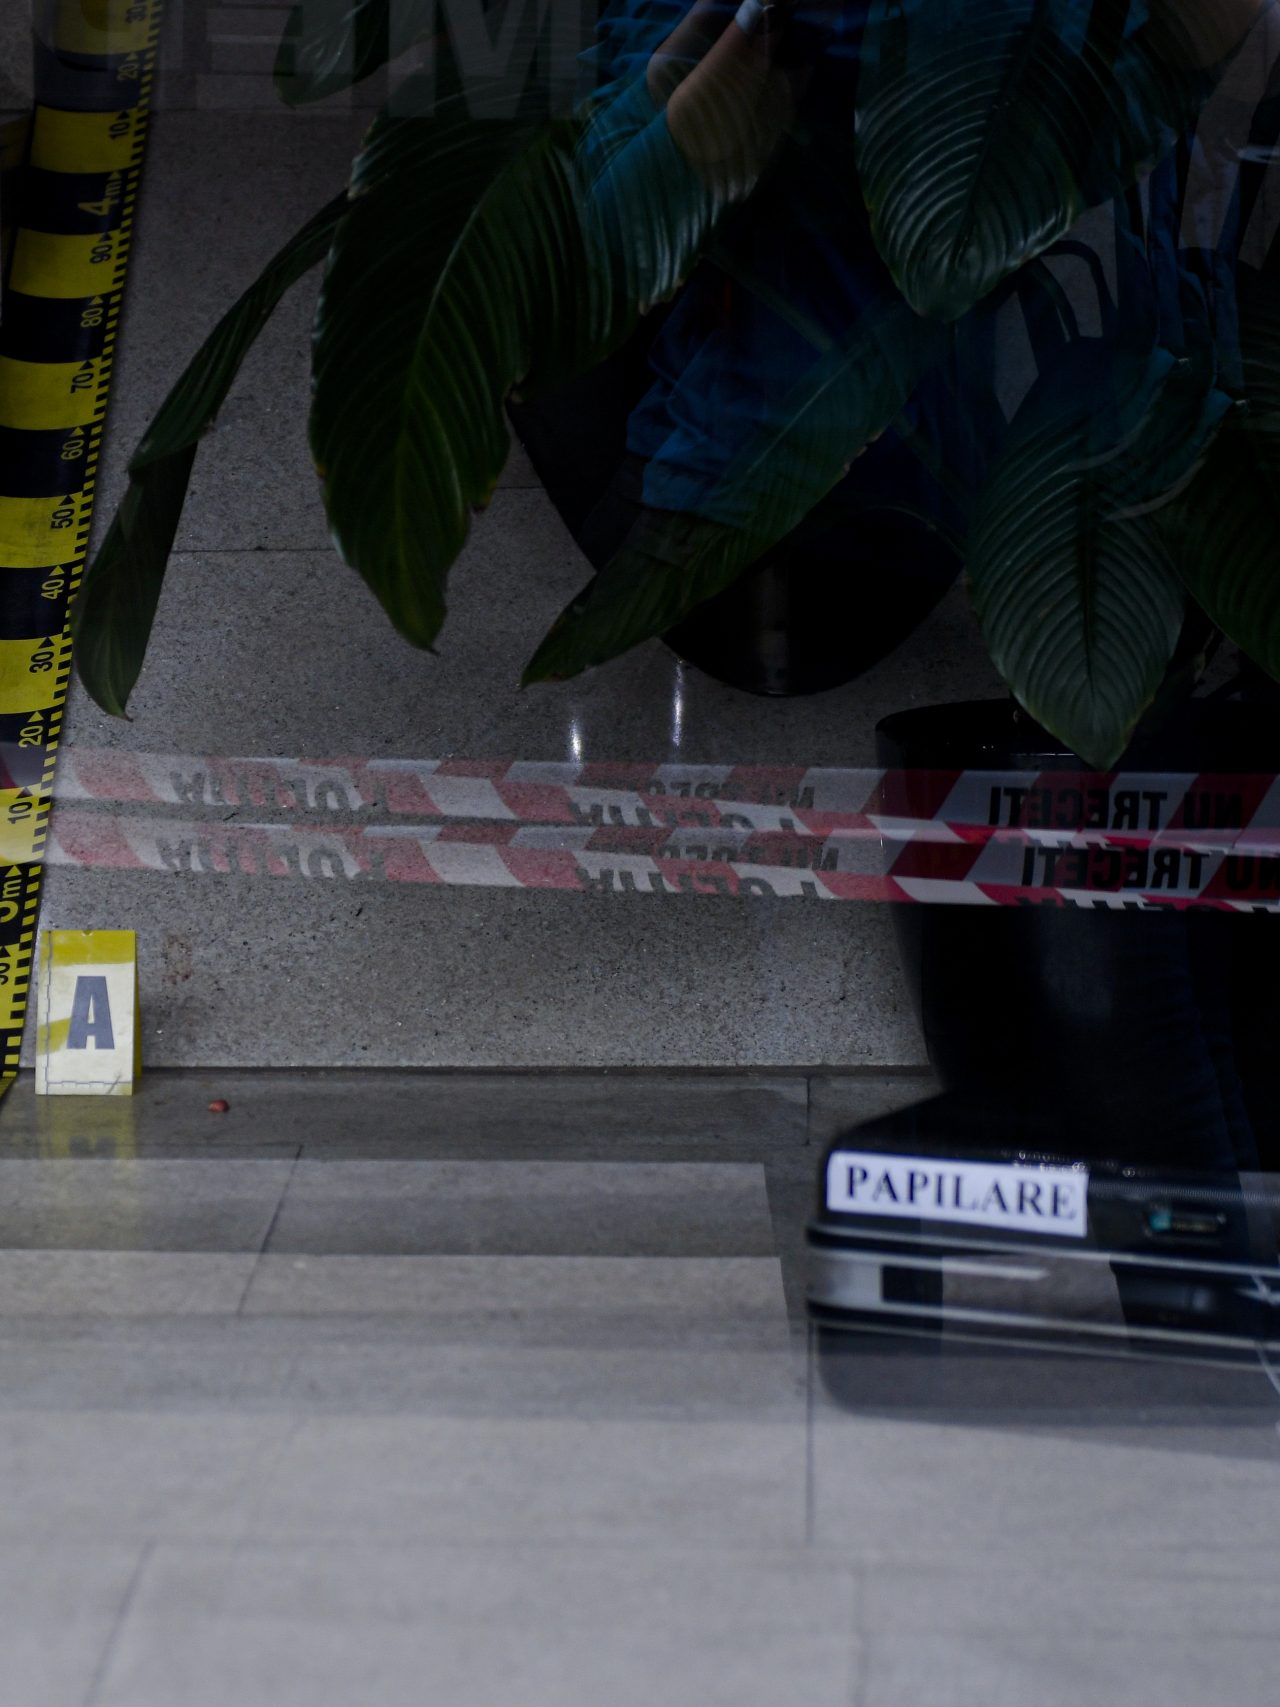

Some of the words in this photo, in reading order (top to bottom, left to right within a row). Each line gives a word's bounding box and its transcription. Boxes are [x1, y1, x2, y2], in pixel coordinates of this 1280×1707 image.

[116, 63, 139, 81] 20
[109, 121, 130, 139] 10
[89, 243, 112, 264] 90
[80, 307, 104, 328] 80
[70, 372, 95, 394] 70
[60, 438, 85, 461] 60
[50, 507, 75, 529] 50
[40, 578, 65, 600] 40
[29, 650, 55, 674] 30
[18, 724, 45, 748] 20
[7, 800, 33, 824] 10
[66, 975, 115, 1050] A
[846, 1166, 1077, 1220] PAPILARE
